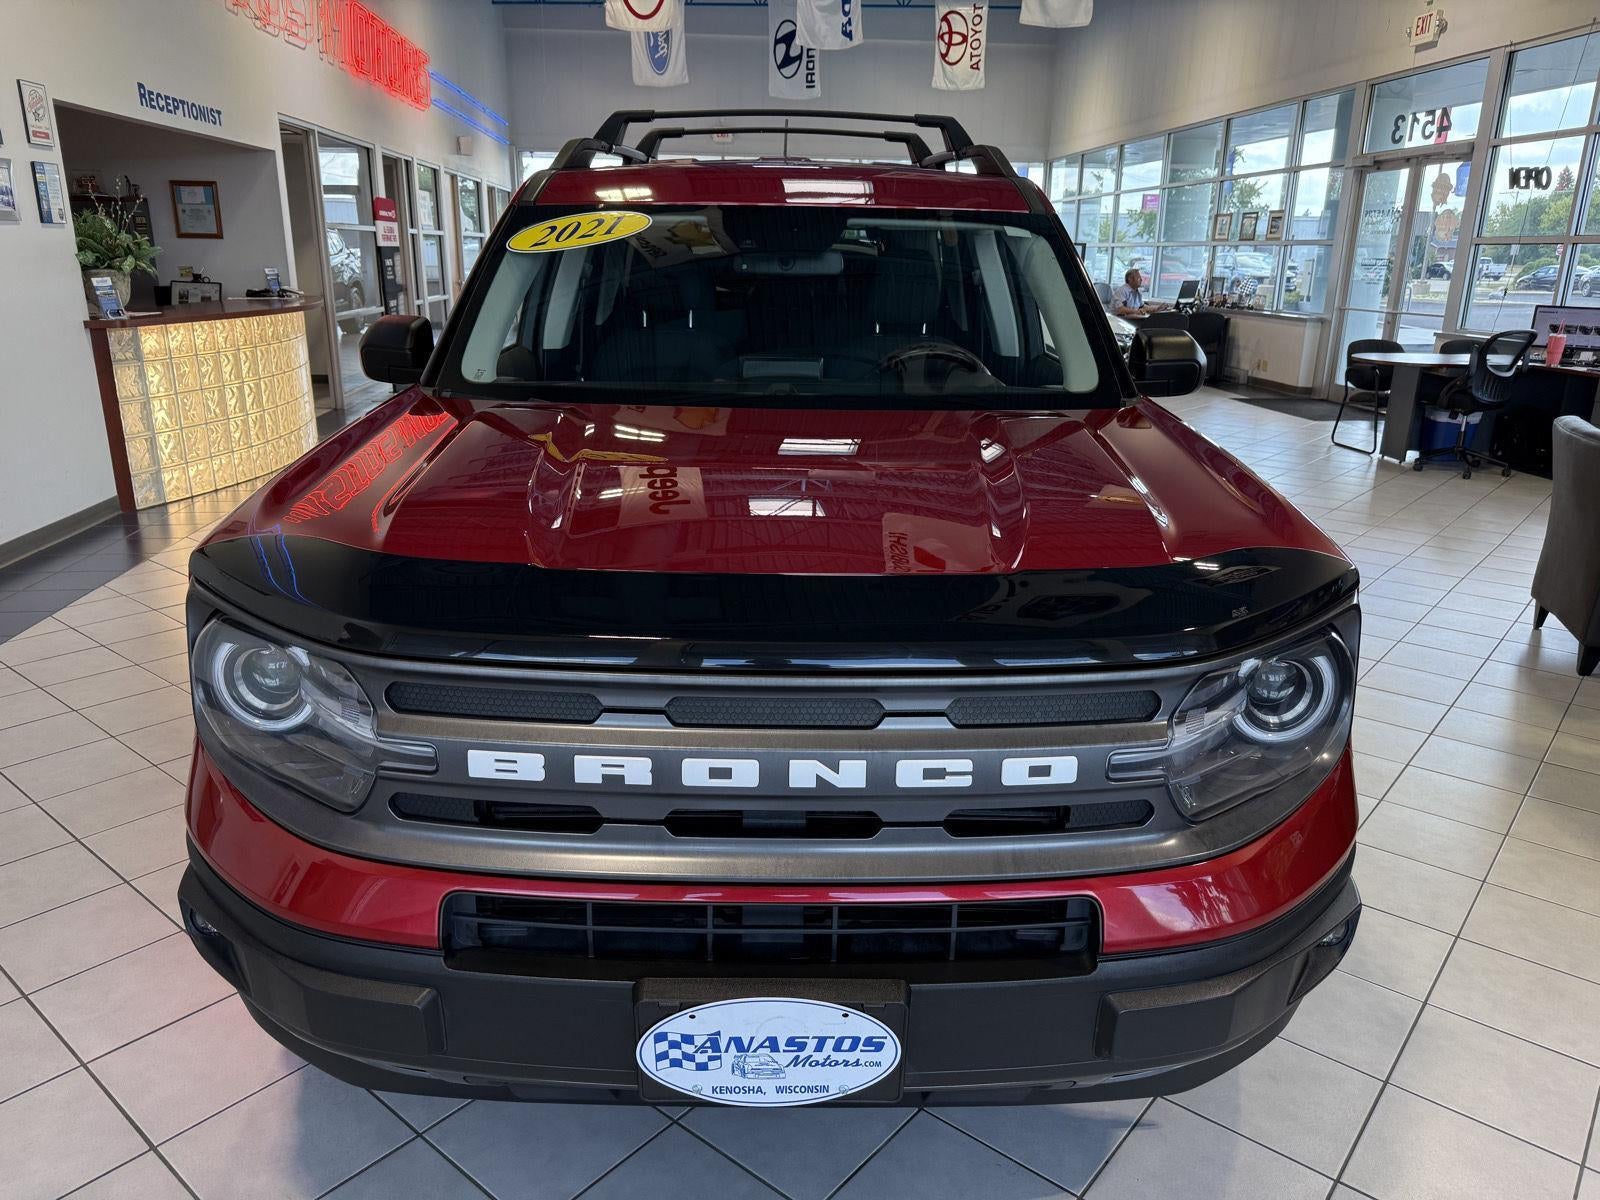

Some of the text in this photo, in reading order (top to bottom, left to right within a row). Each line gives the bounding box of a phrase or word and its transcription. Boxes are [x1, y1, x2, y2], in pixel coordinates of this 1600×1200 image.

[1415, 13, 1433, 37] EXIT
[317, 0, 431, 111] MOTORS
[529, 215, 625, 248] 2021
[467, 749, 1079, 789] BRONCO
[692, 1035, 888, 1054] ANASTOS
[711, 1084, 830, 1096] KENOSHA, WISCONSIN
